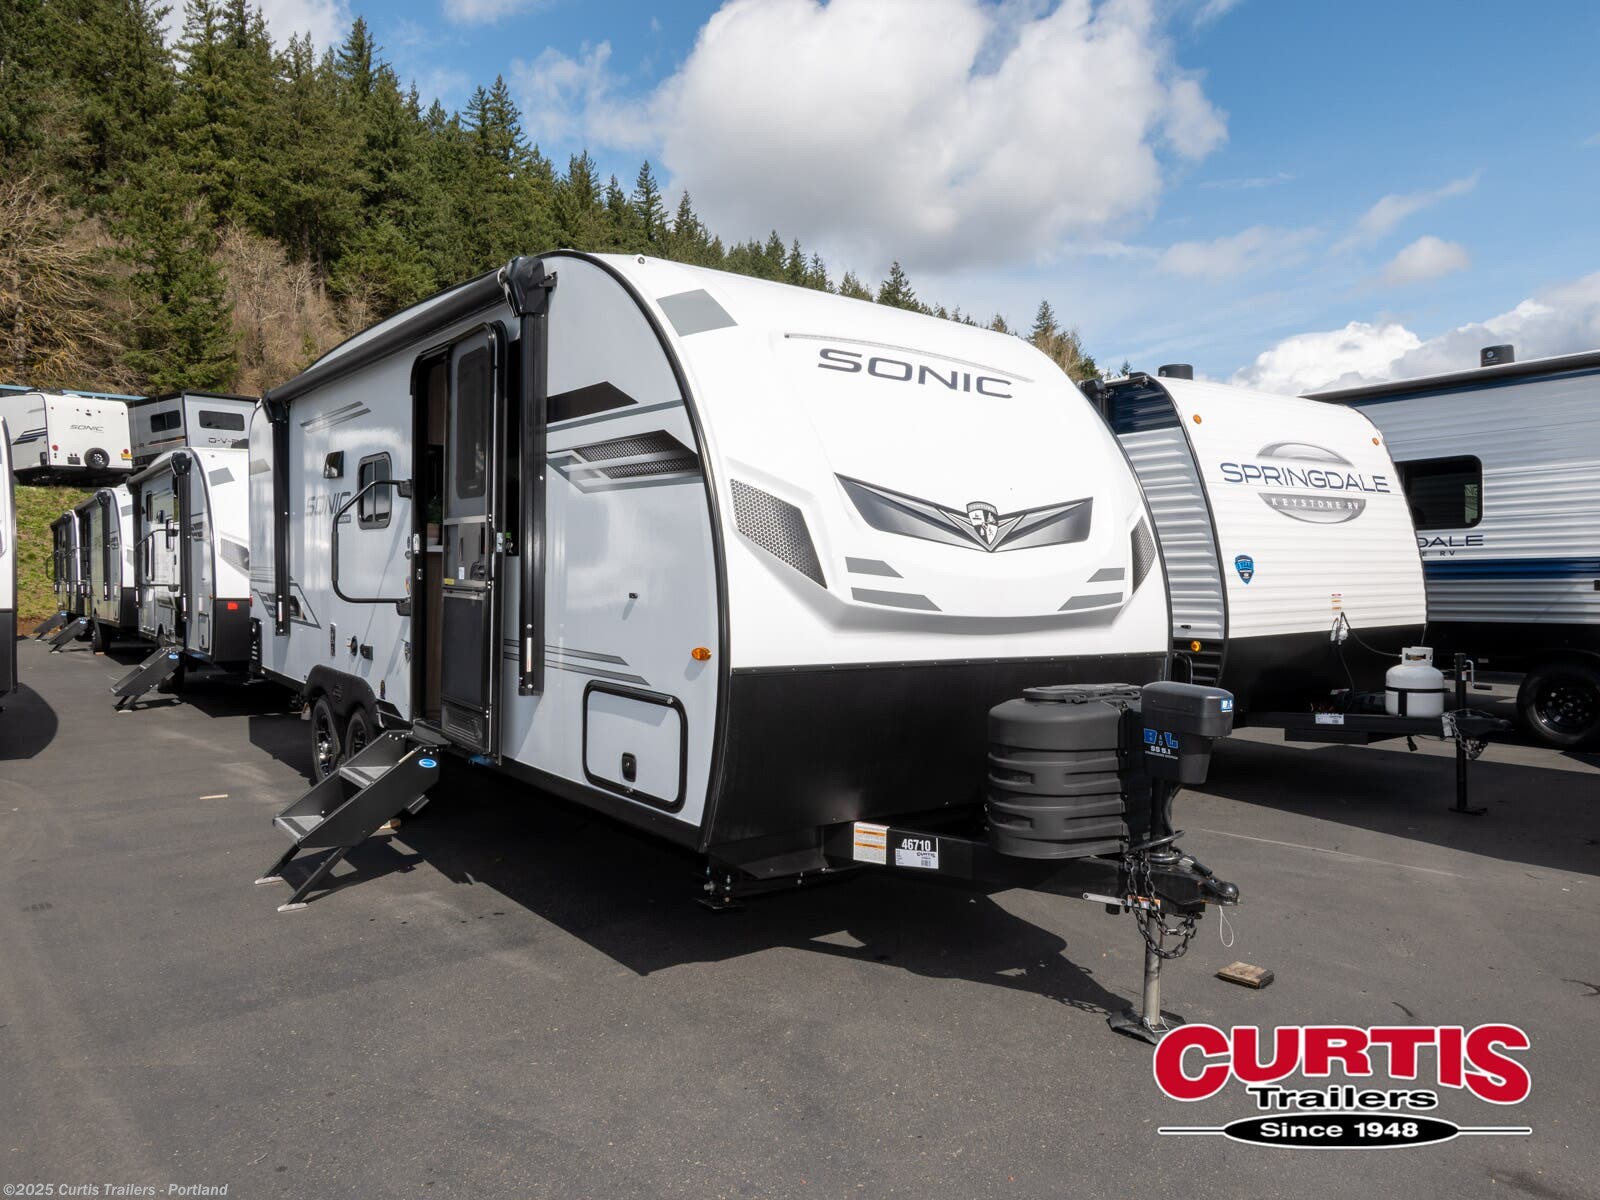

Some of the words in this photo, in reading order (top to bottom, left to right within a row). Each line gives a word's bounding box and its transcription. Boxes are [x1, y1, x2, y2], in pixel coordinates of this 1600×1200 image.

[817, 347, 1013, 399] SONIC
[69, 424, 104, 433] SONIC
[1220, 462, 1390, 493] SPRINGDALE
[1271, 497, 1342, 510] KEYSTONE
[1347, 502, 1359, 510] RV
[901, 838, 931, 852] 46710
